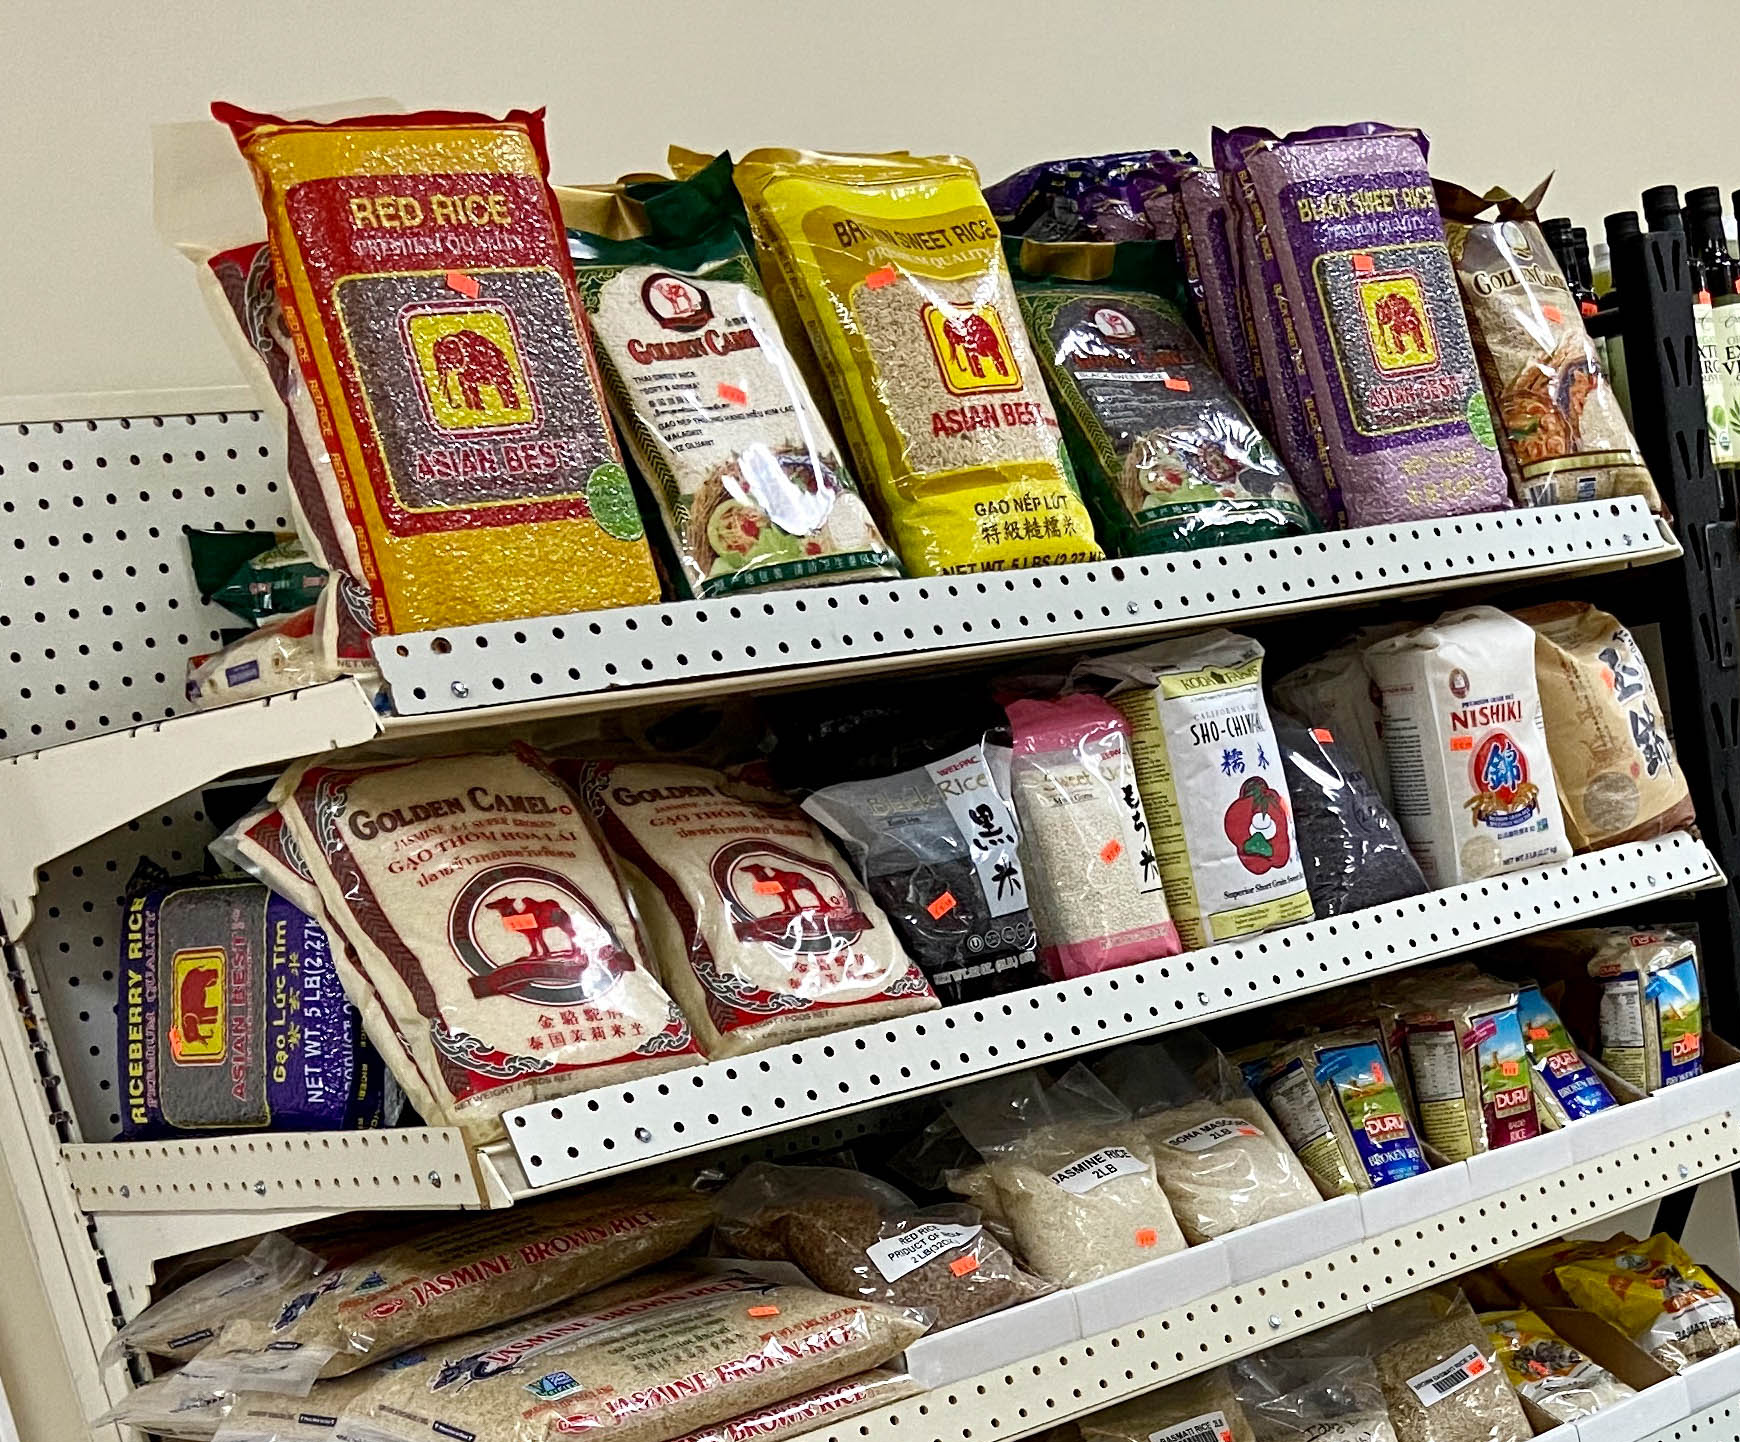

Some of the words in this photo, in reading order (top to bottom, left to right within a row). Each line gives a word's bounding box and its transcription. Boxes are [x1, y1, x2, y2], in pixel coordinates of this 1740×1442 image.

[350, 195, 423, 229] RED
[431, 194, 512, 227] RICE
[1298, 193, 1350, 222] BLACK
[1352, 190, 1398, 216] SWEET
[1402, 186, 1436, 211] RICE
[1367, 380, 1418, 409] ASIAN
[931, 404, 1000, 438] ASIAN
[1003, 401, 1046, 432] BEST
[415, 446, 498, 480] ASIAN
[503, 442, 573, 474] BEST
[1180, 672, 1215, 692] KODA
[1449, 699, 1523, 732] NISHIKI
[611, 785, 715, 808] GOLDEN
[937, 772, 992, 801] Rice
[349, 798, 462, 841] GOLDEN
[466, 786, 558, 815] CAMEL
[127, 896, 148, 960] RICE
[230, 935, 247, 1008] BEST
[304, 1006, 322, 1019] 5
[127, 969, 148, 1125] RICEBERRY
[303, 1023, 324, 1058] WT.
[230, 1015, 247, 1102] ASIAN
[1550, 1051, 1580, 1069] DURU
[307, 1063, 325, 1104] NET
[1495, 1087, 1529, 1109] DURU
[1209, 1128, 1233, 1141] 2LB
[1366, 1116, 1405, 1134] DURU
[1051, 1152, 1108, 1186] JASMINE
[1106, 1147, 1132, 1161] RICE
[1091, 1163, 1118, 1180] 2LB
[1367, 1149, 1407, 1167] BROKEN
[899, 1231, 919, 1246] RED
[919, 1224, 941, 1236] RICE
[410, 1255, 514, 1309] JASMINE
[519, 1223, 610, 1265] BROWN
[609, 1207, 664, 1239] RICE
[484, 1317, 598, 1366] JASMINE
[605, 1372, 717, 1426] JASMINE
[817, 1381, 866, 1413] RICE
[1194, 1420, 1213, 1435] RICE
